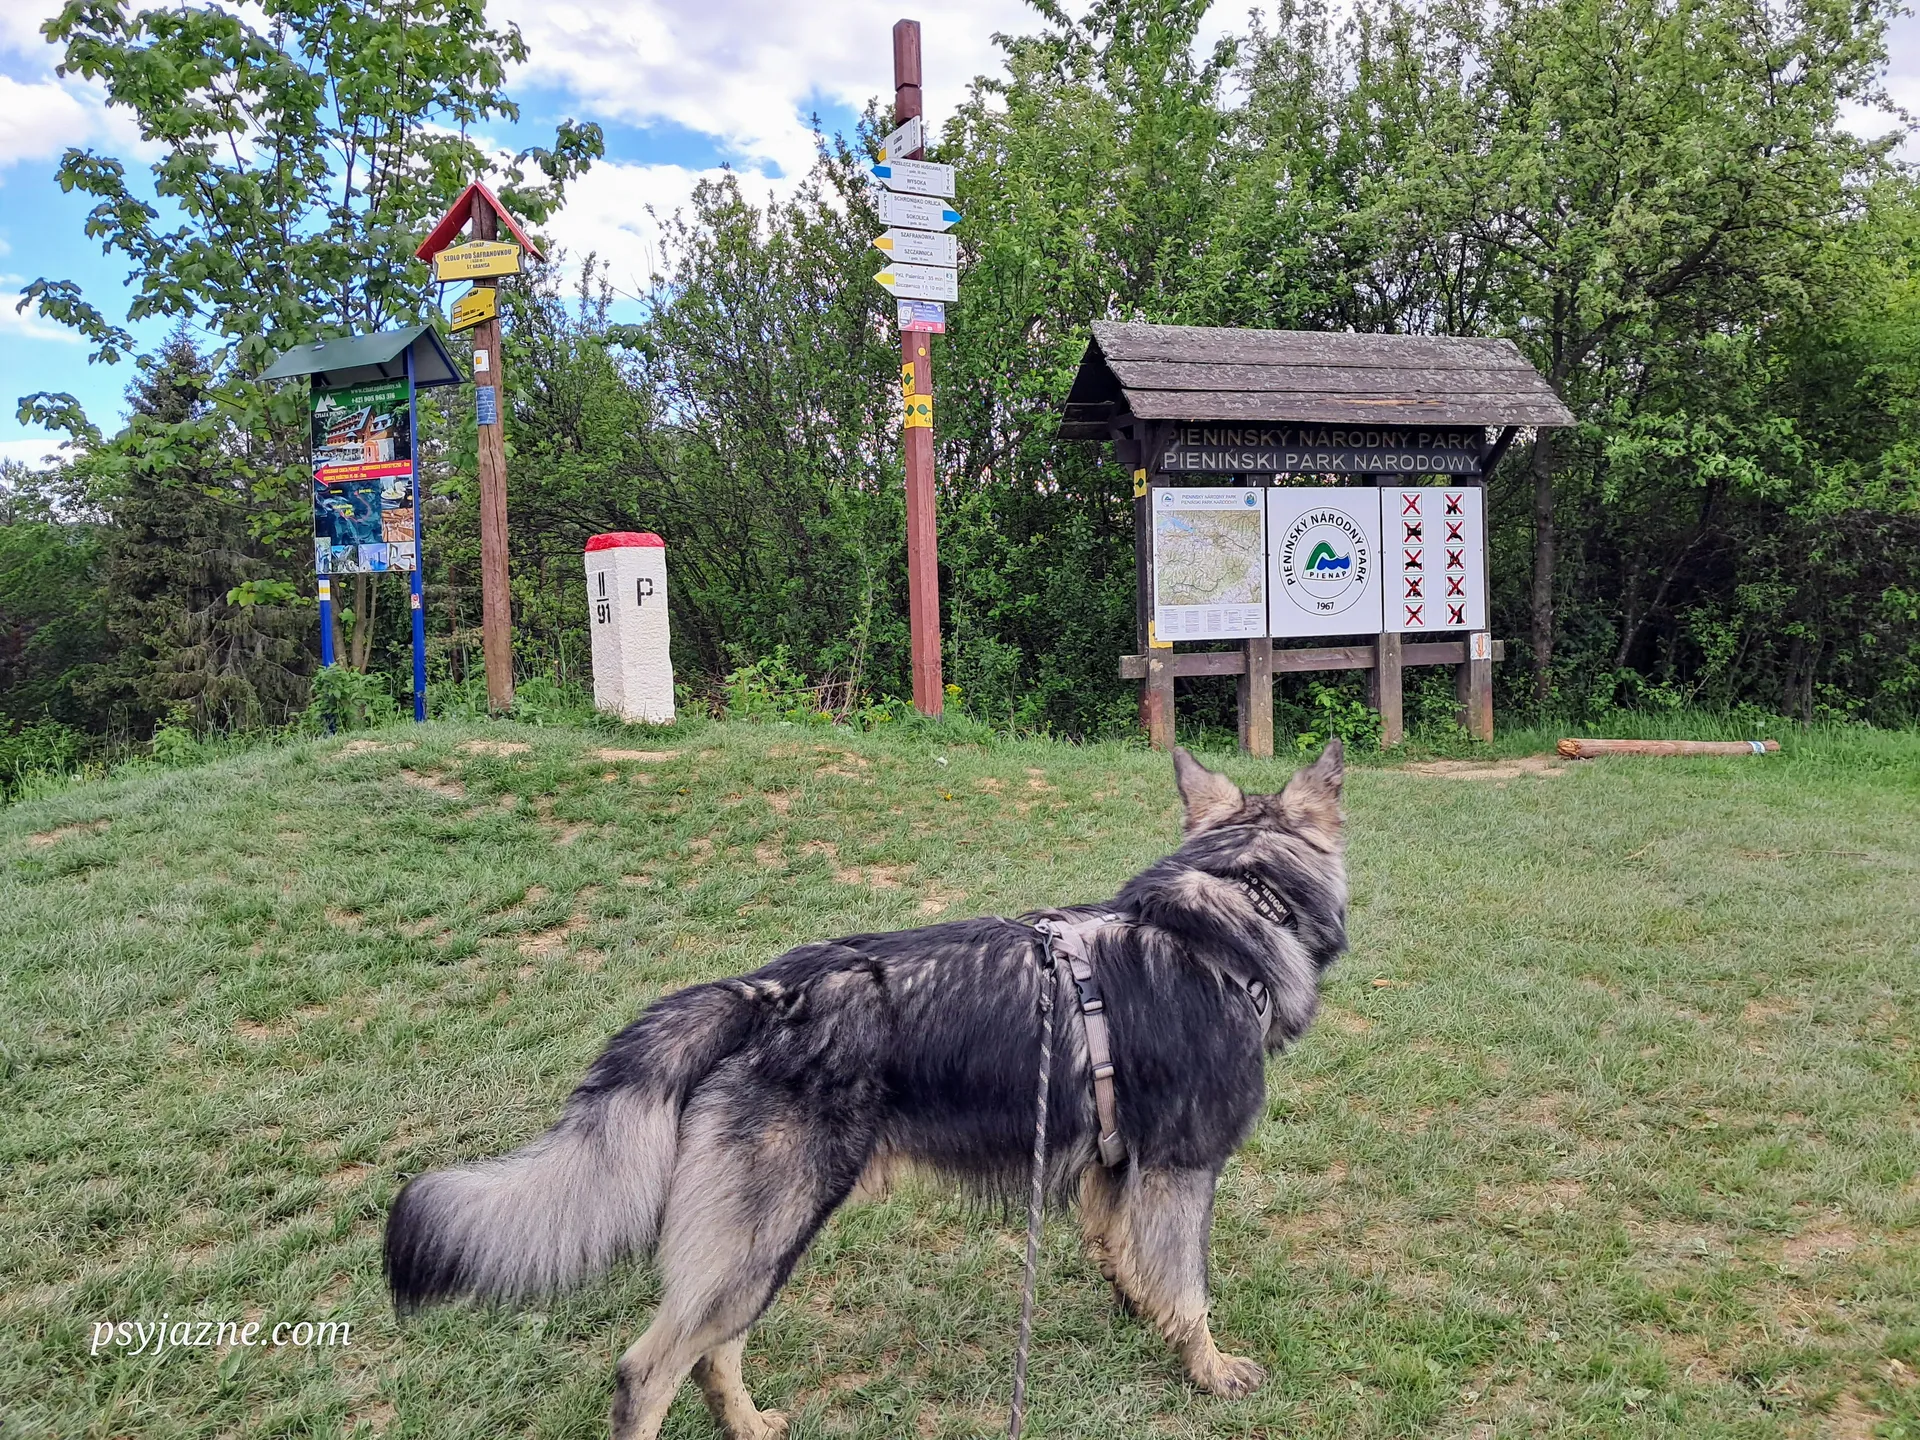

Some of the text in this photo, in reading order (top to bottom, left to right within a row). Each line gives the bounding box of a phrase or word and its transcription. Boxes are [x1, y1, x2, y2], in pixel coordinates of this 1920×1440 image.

[894, 196, 924, 204] SCHRONISKO
[473, 249, 512, 258] ŠAFRANOVKOU
[1167, 426, 1292, 447] PIENINSKÝ
[1418, 433, 1477, 449] PARK
[1164, 448, 1479, 472] PIENIŃSKI PARK NARODOWY
[1283, 511, 1366, 586] PIENINSKÝ NÁRODNÝ PARK
[1309, 571, 1346, 579] PIENAP
[637, 578, 653, 606] P
[597, 603, 611, 624] 91
[1316, 602, 1334, 610] 1967
